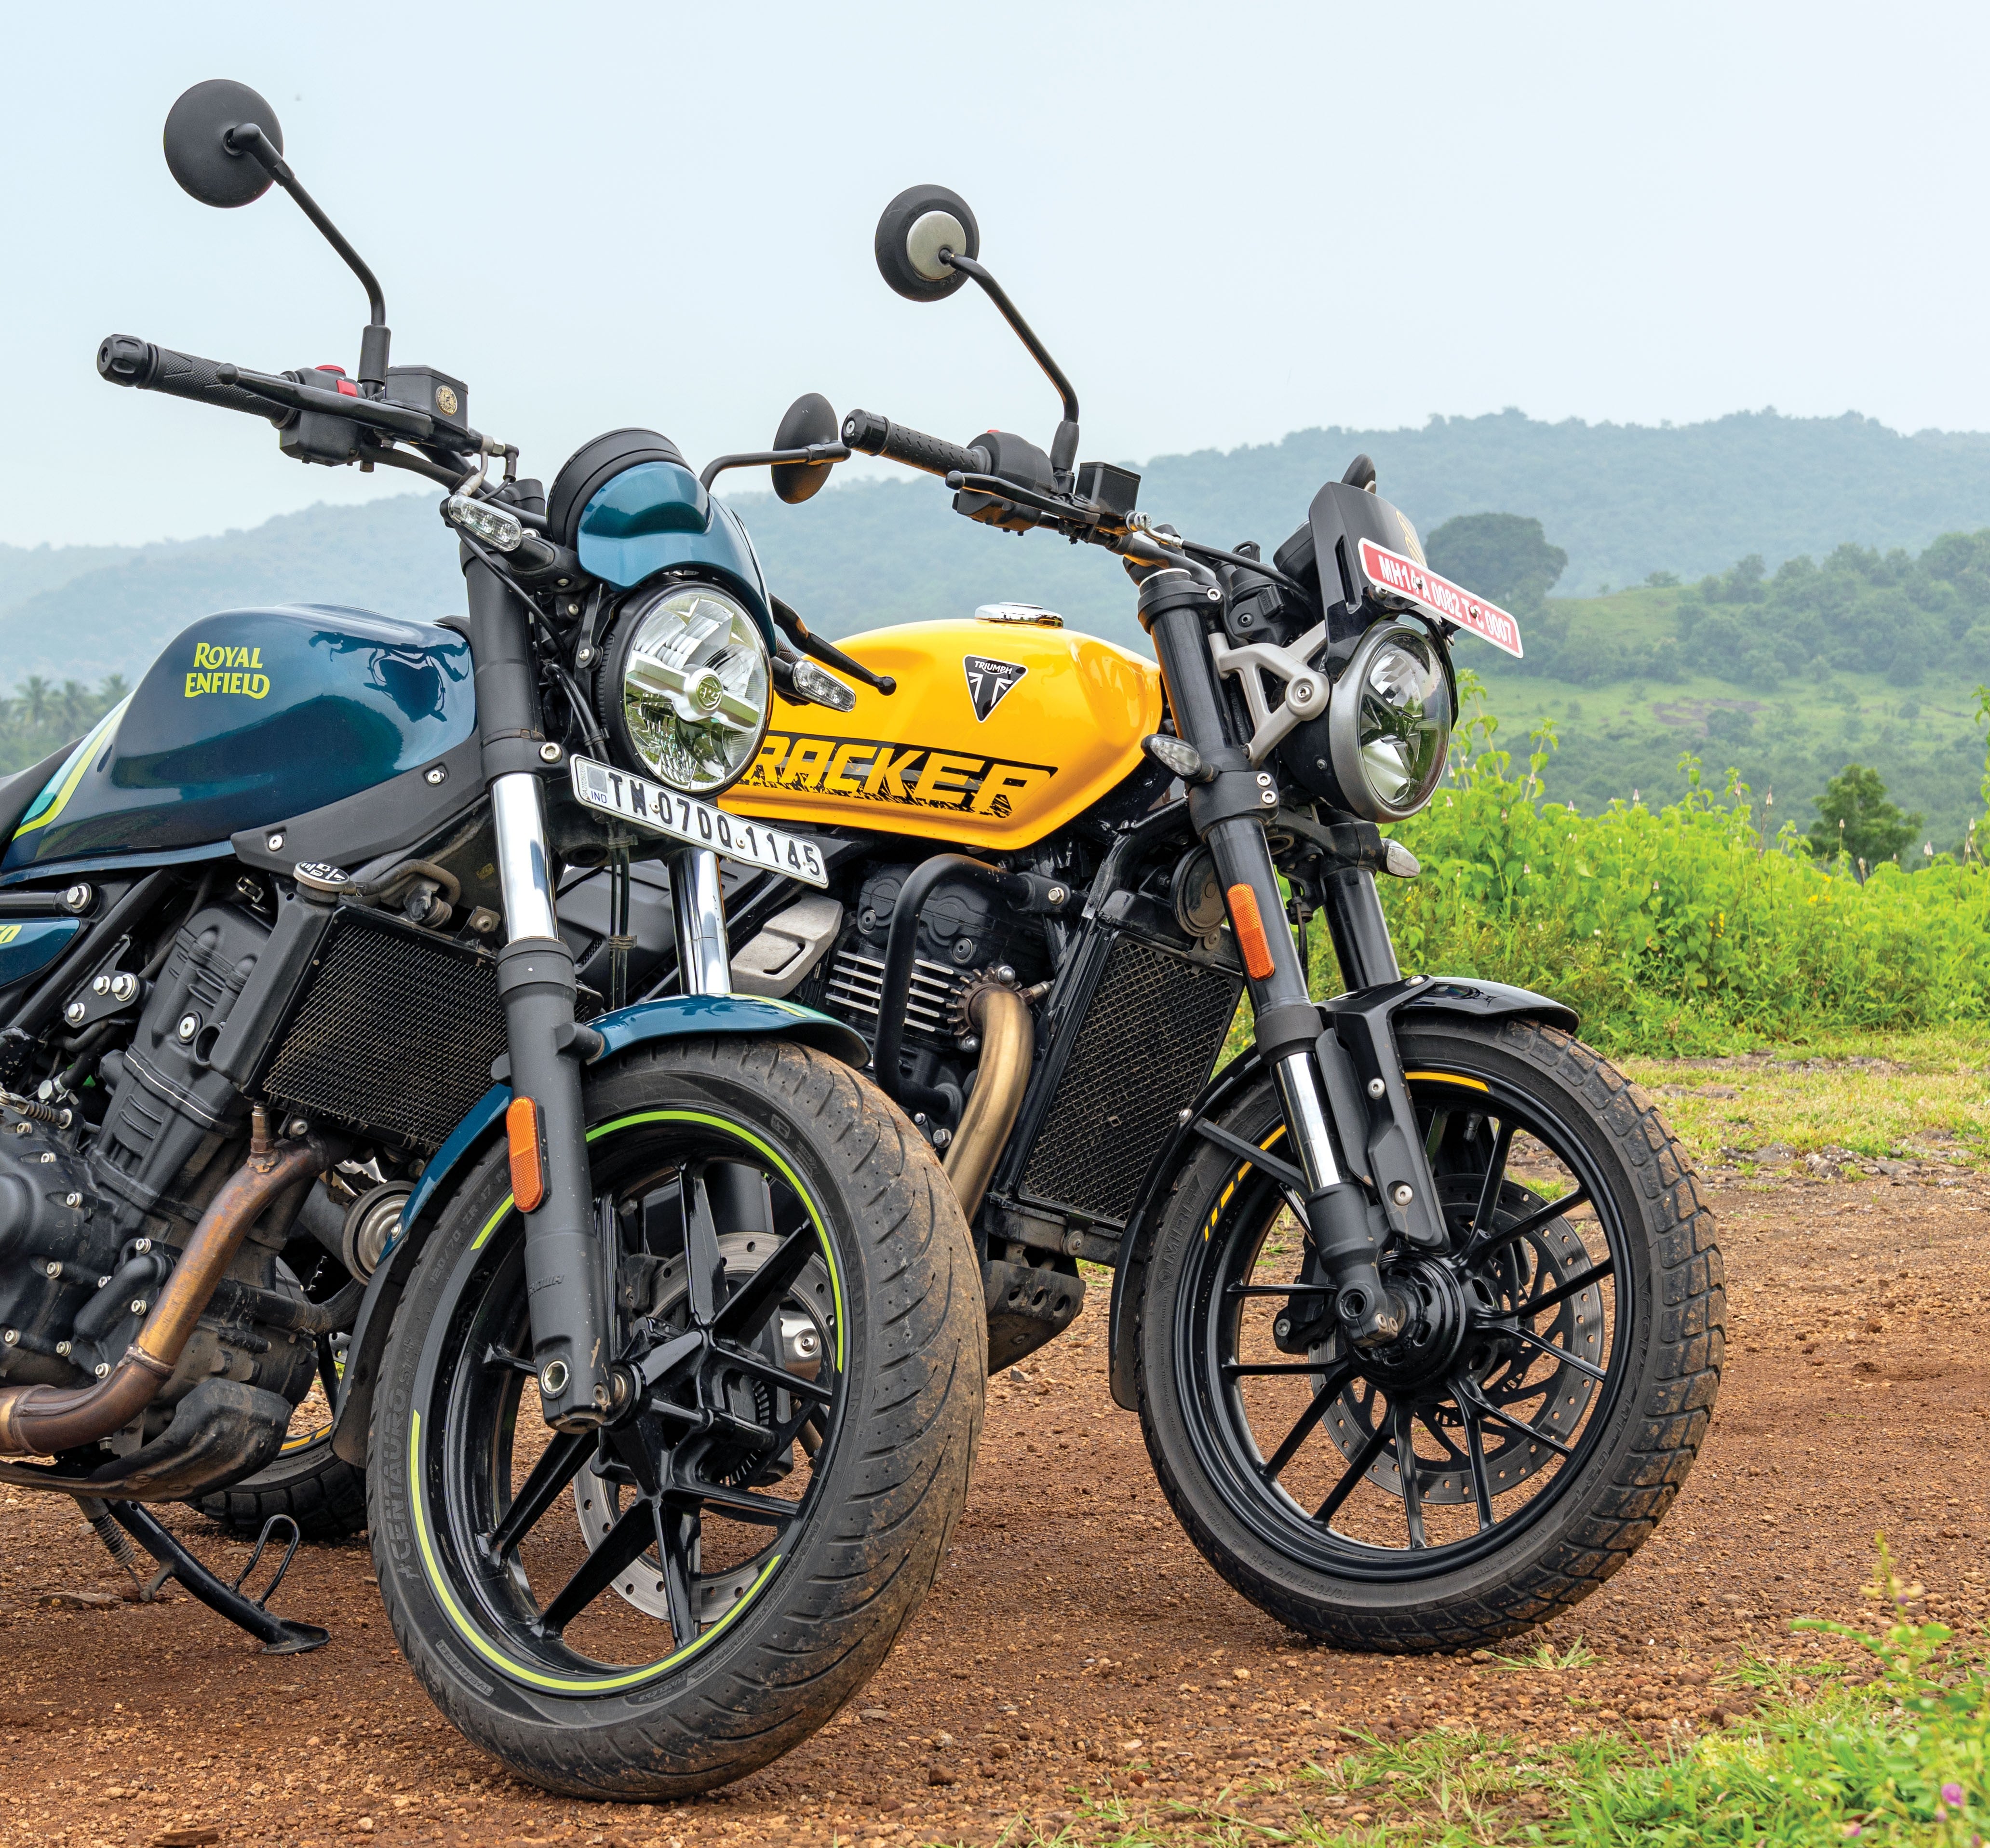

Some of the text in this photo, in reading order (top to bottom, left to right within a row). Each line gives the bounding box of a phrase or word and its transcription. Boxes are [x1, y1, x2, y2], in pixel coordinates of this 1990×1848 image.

[1432, 585, 1461, 617] 0082
[1484, 610, 1512, 645] 0007
[193, 643, 263, 670] ROYAL
[975, 661, 1013, 674] TRIUMPH
[185, 673, 270, 699] ENFIELD
[740, 735, 1050, 816] RACKER
[591, 791, 607, 804] IND
[1163, 1188, 1196, 1264] MRF
[383, 1387, 411, 1562] CENTAURO
[638, 1673, 687, 1702] TUBELESS
